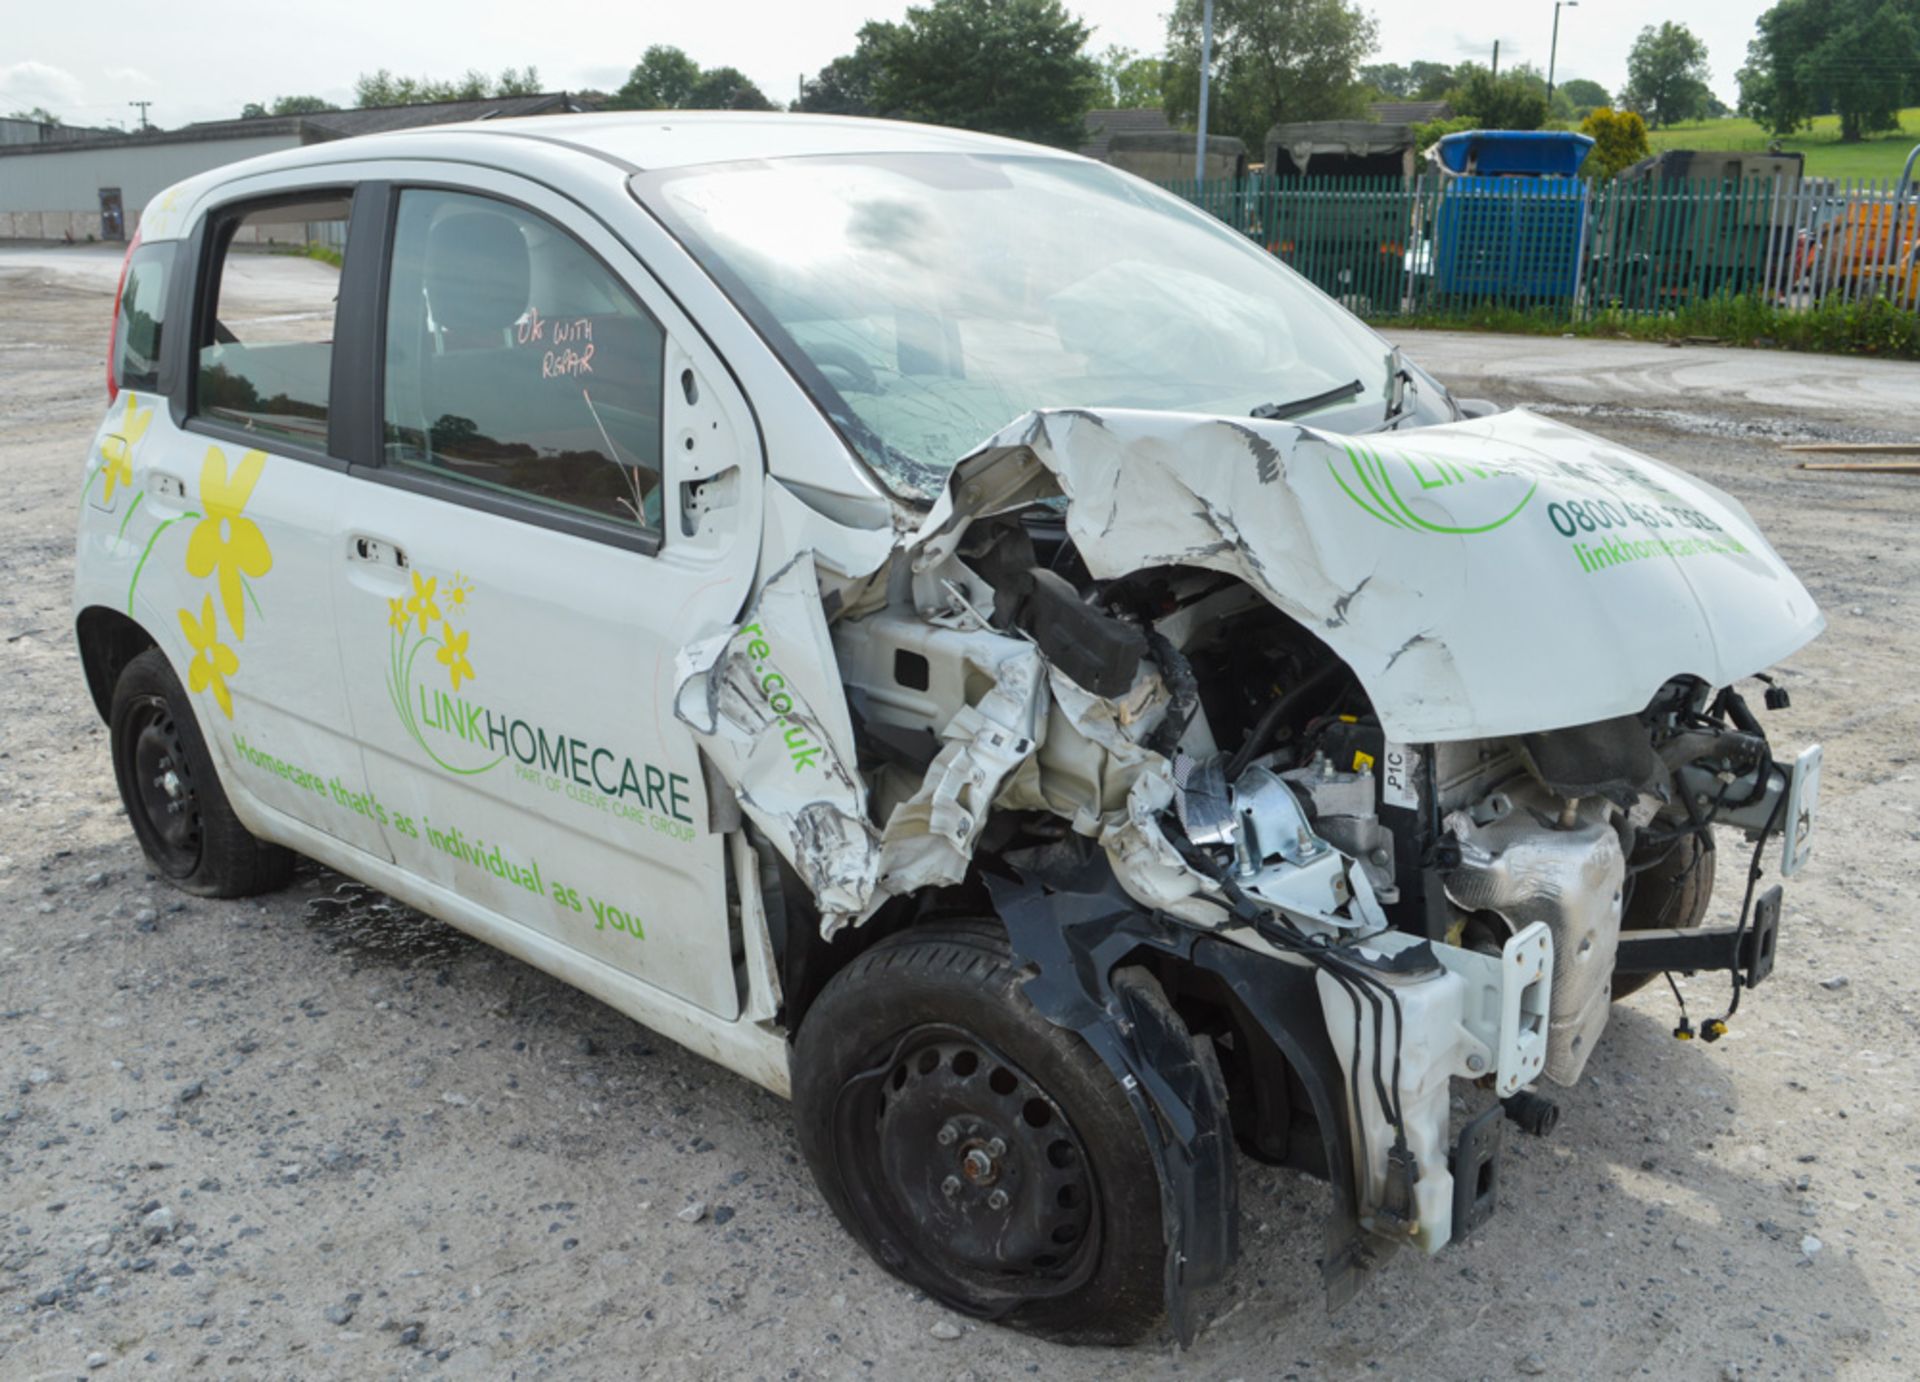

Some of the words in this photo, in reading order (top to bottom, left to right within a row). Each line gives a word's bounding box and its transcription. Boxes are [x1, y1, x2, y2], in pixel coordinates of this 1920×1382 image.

[554, 318, 592, 345] WITH
[1547, 499, 1627, 537] 0800
[515, 764, 541, 785] PART
[545, 776, 561, 794] OF
[566, 784, 609, 812] CLEEVE
[612, 801, 645, 826] CARE
[650, 814, 696, 843] GROUP
[232, 732, 327, 797] Homecare
[329, 776, 388, 825] that's
[393, 811, 418, 839] as
[424, 816, 545, 896] individual
[552, 881, 583, 912] as
[587, 896, 645, 940] you
